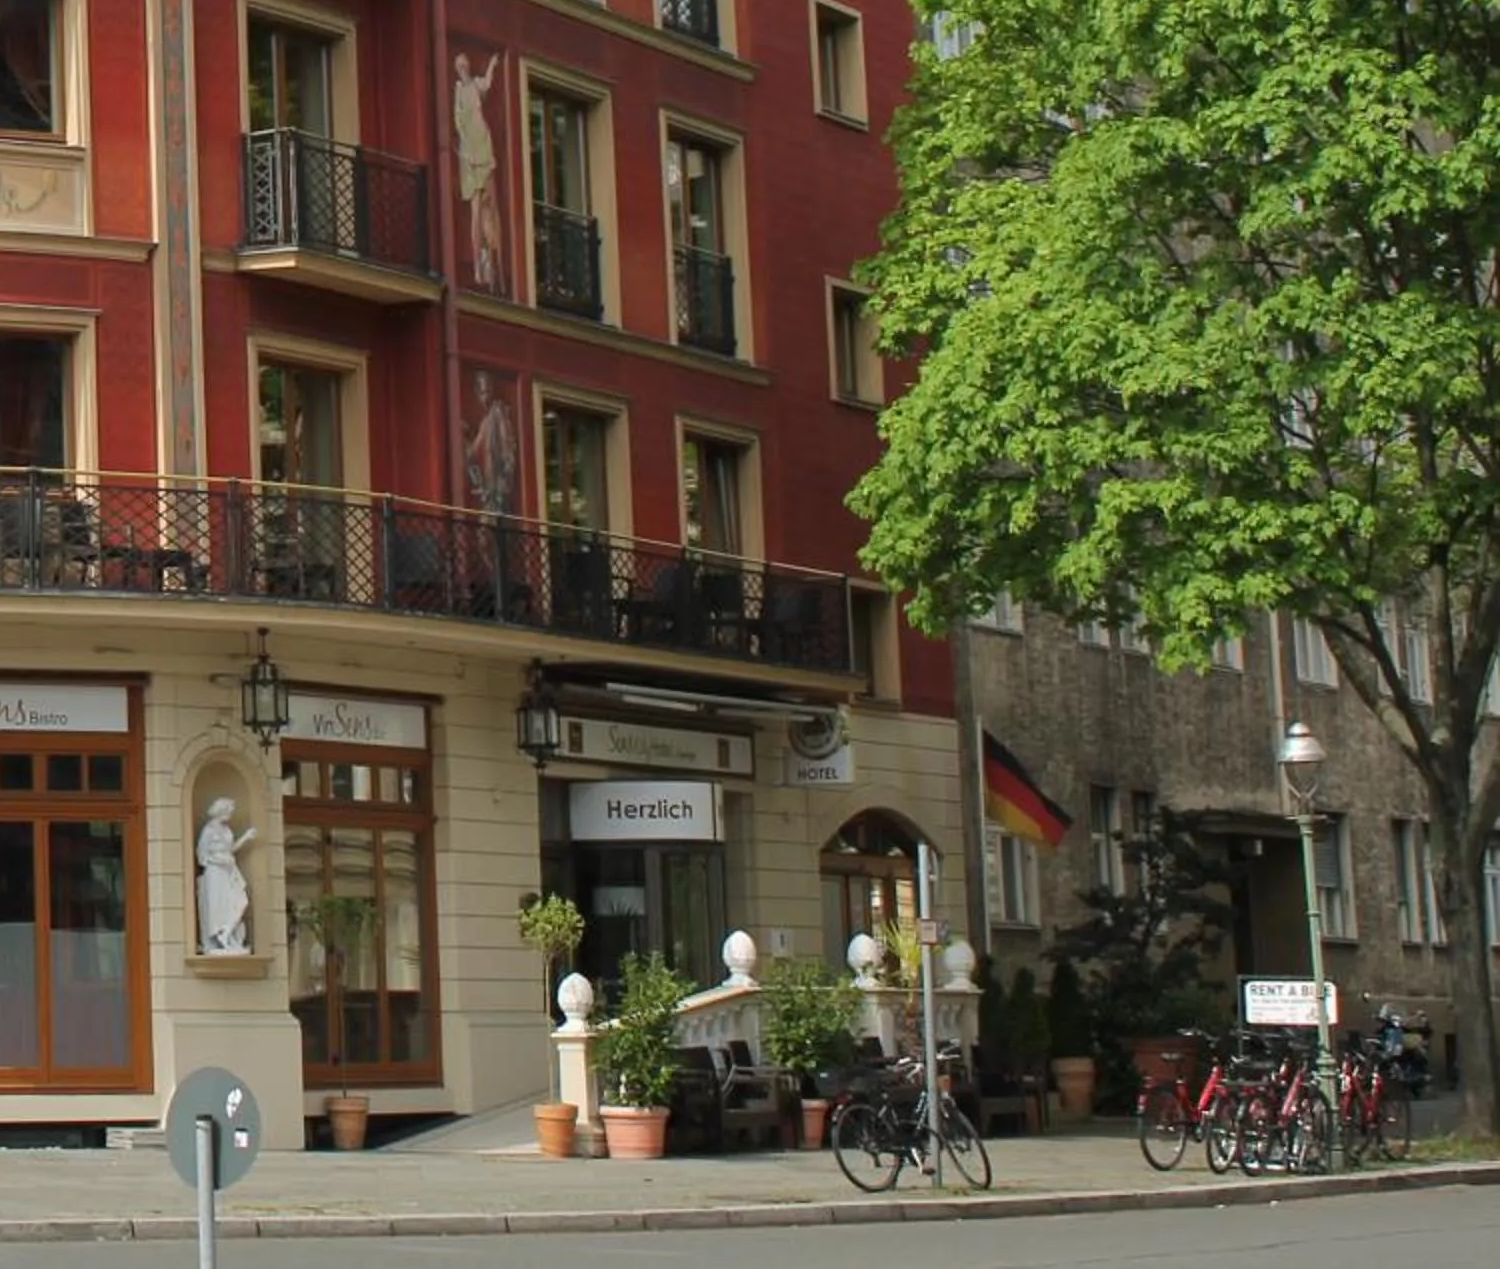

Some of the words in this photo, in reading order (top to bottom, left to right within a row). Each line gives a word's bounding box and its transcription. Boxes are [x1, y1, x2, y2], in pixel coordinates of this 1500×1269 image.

[29, 711, 68, 725] Bistro
[798, 767, 838, 780] HOTEL
[607, 798, 693, 819] Herzlich
[1250, 984, 1284, 996] RENT
[1288, 985, 1297, 995] A
[1301, 985, 1332, 996] BIE
